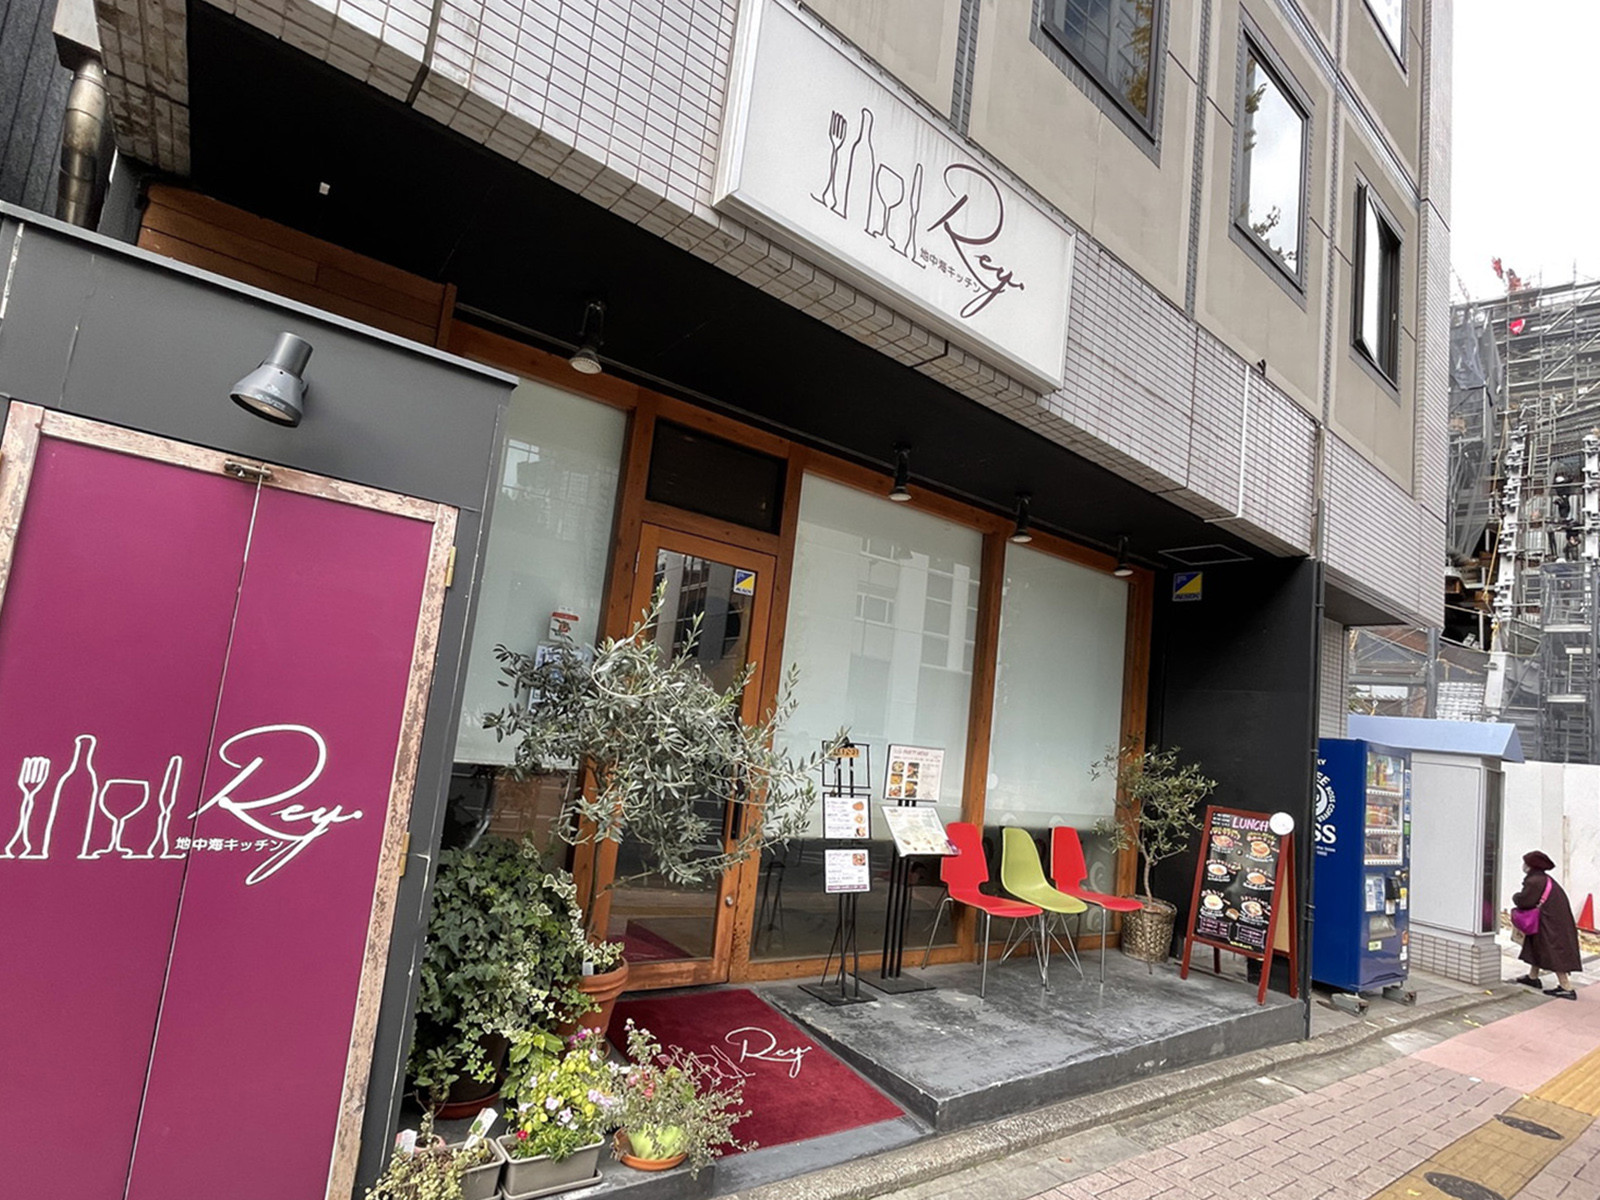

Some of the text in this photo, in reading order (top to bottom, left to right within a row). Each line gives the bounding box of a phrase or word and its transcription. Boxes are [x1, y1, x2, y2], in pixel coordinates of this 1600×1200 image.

[919, 246, 982, 294] 地中海キッチン
[187, 723, 364, 887] Rey
[1232, 816, 1269, 832] LUNCH
[174, 835, 285, 853] 地中海キッチン
